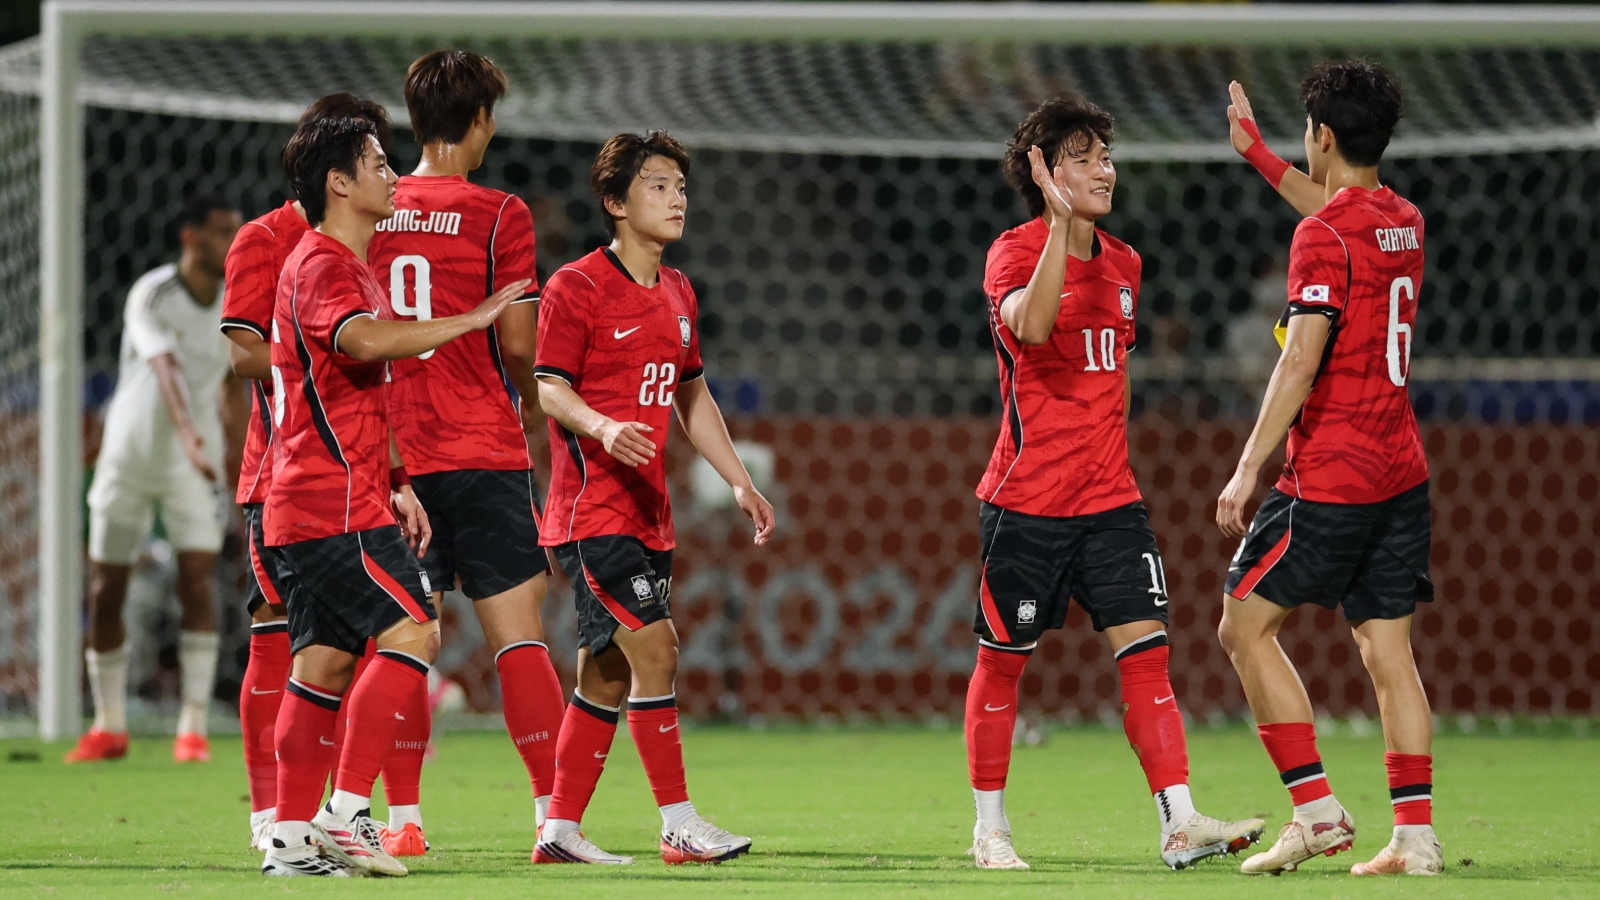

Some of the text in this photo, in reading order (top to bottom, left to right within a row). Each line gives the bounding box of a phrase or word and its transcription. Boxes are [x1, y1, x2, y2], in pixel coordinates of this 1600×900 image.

[1375, 226, 1420, 252] GIHYUK
[389, 254, 433, 360] 9
[1081, 328, 1116, 372] 10
[1386, 276, 1414, 387] 6
[639, 362, 676, 406] 22
[515, 730, 549, 747] KOREA
